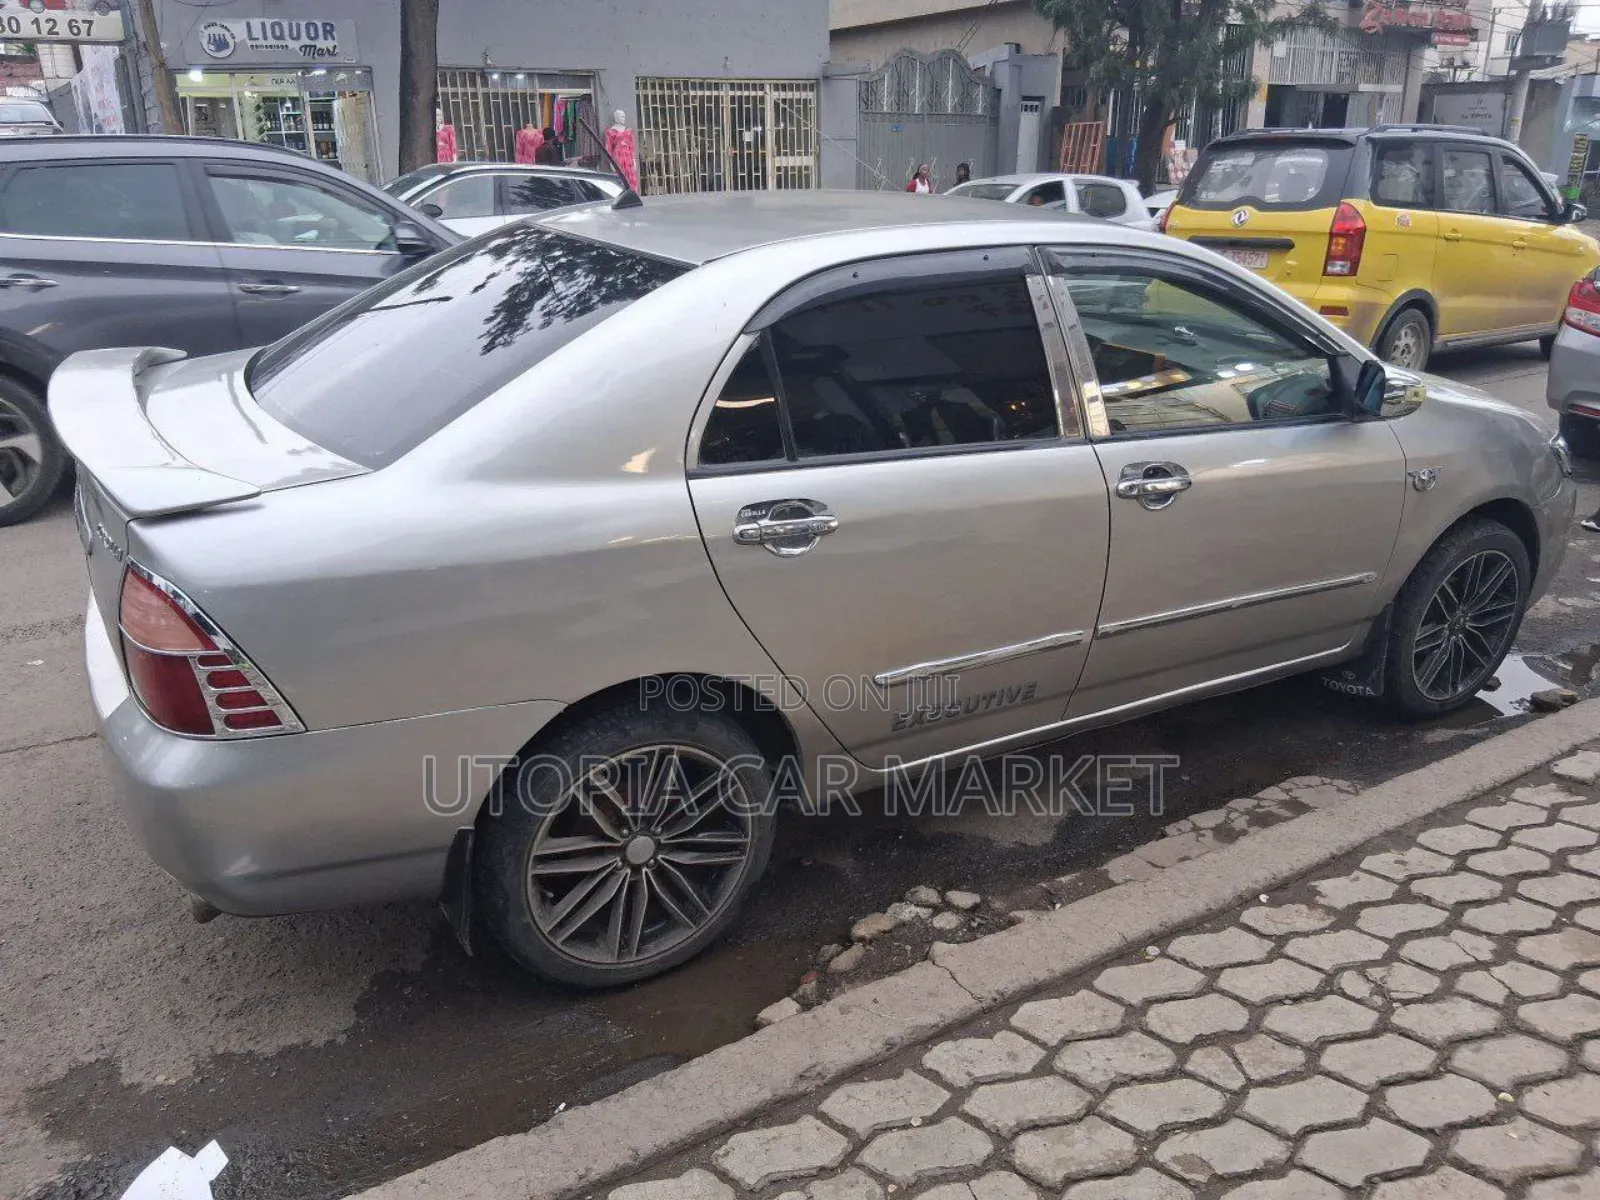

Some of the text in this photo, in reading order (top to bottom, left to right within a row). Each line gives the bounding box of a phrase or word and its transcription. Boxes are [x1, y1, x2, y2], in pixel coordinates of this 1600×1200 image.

[30, 17, 60, 36] 12
[67, 18, 95, 37] 67
[245, 20, 337, 42] LIQUOR
[1321, 677, 1376, 696] TOYOTA
[891, 681, 1037, 732] EXECUTIVE
